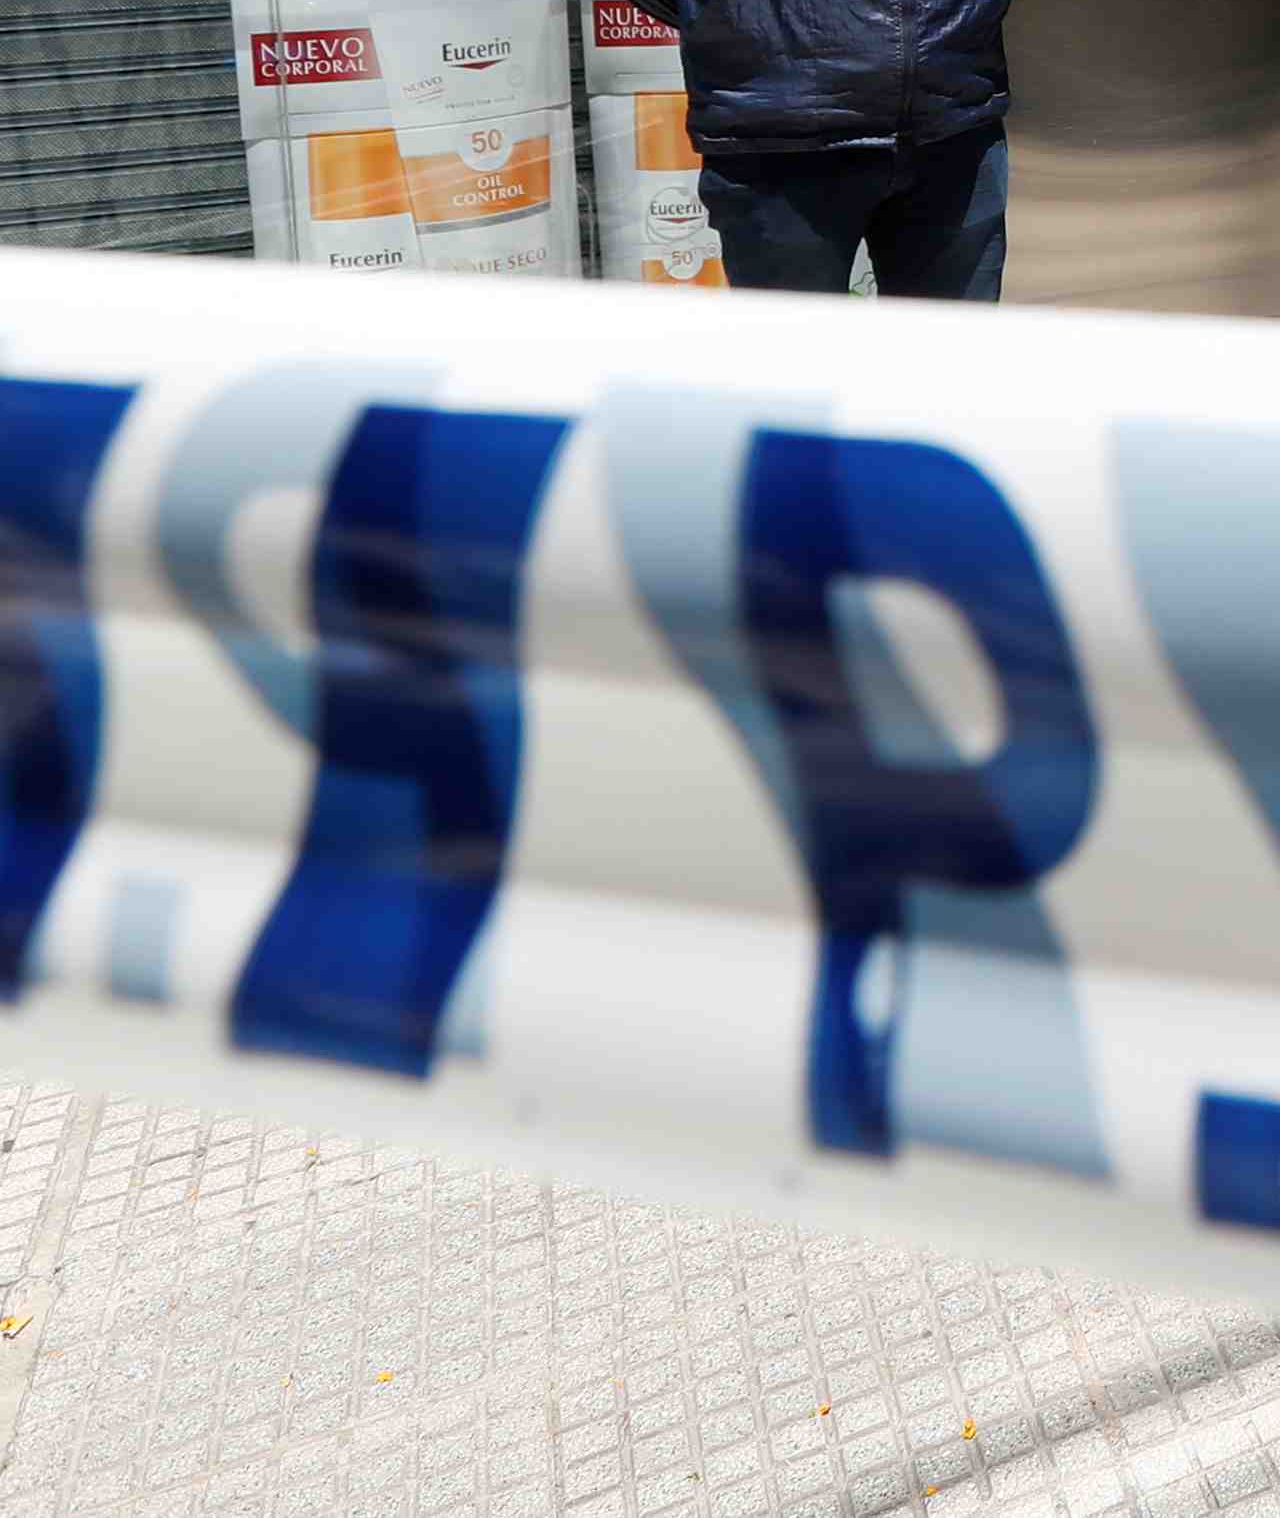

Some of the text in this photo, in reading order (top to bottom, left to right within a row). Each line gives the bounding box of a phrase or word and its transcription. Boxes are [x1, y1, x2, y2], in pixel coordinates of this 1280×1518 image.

[599, 7, 656, 25] NUE
[260, 36, 366, 62] NUEVO
[442, 37, 511, 62] Eucerin
[261, 57, 369, 78] CORPORAL
[471, 129, 503, 153] 50
[477, 175, 503, 190] OIL
[453, 184, 525, 206] CONTROL
[507, 247, 548, 271] SECO
